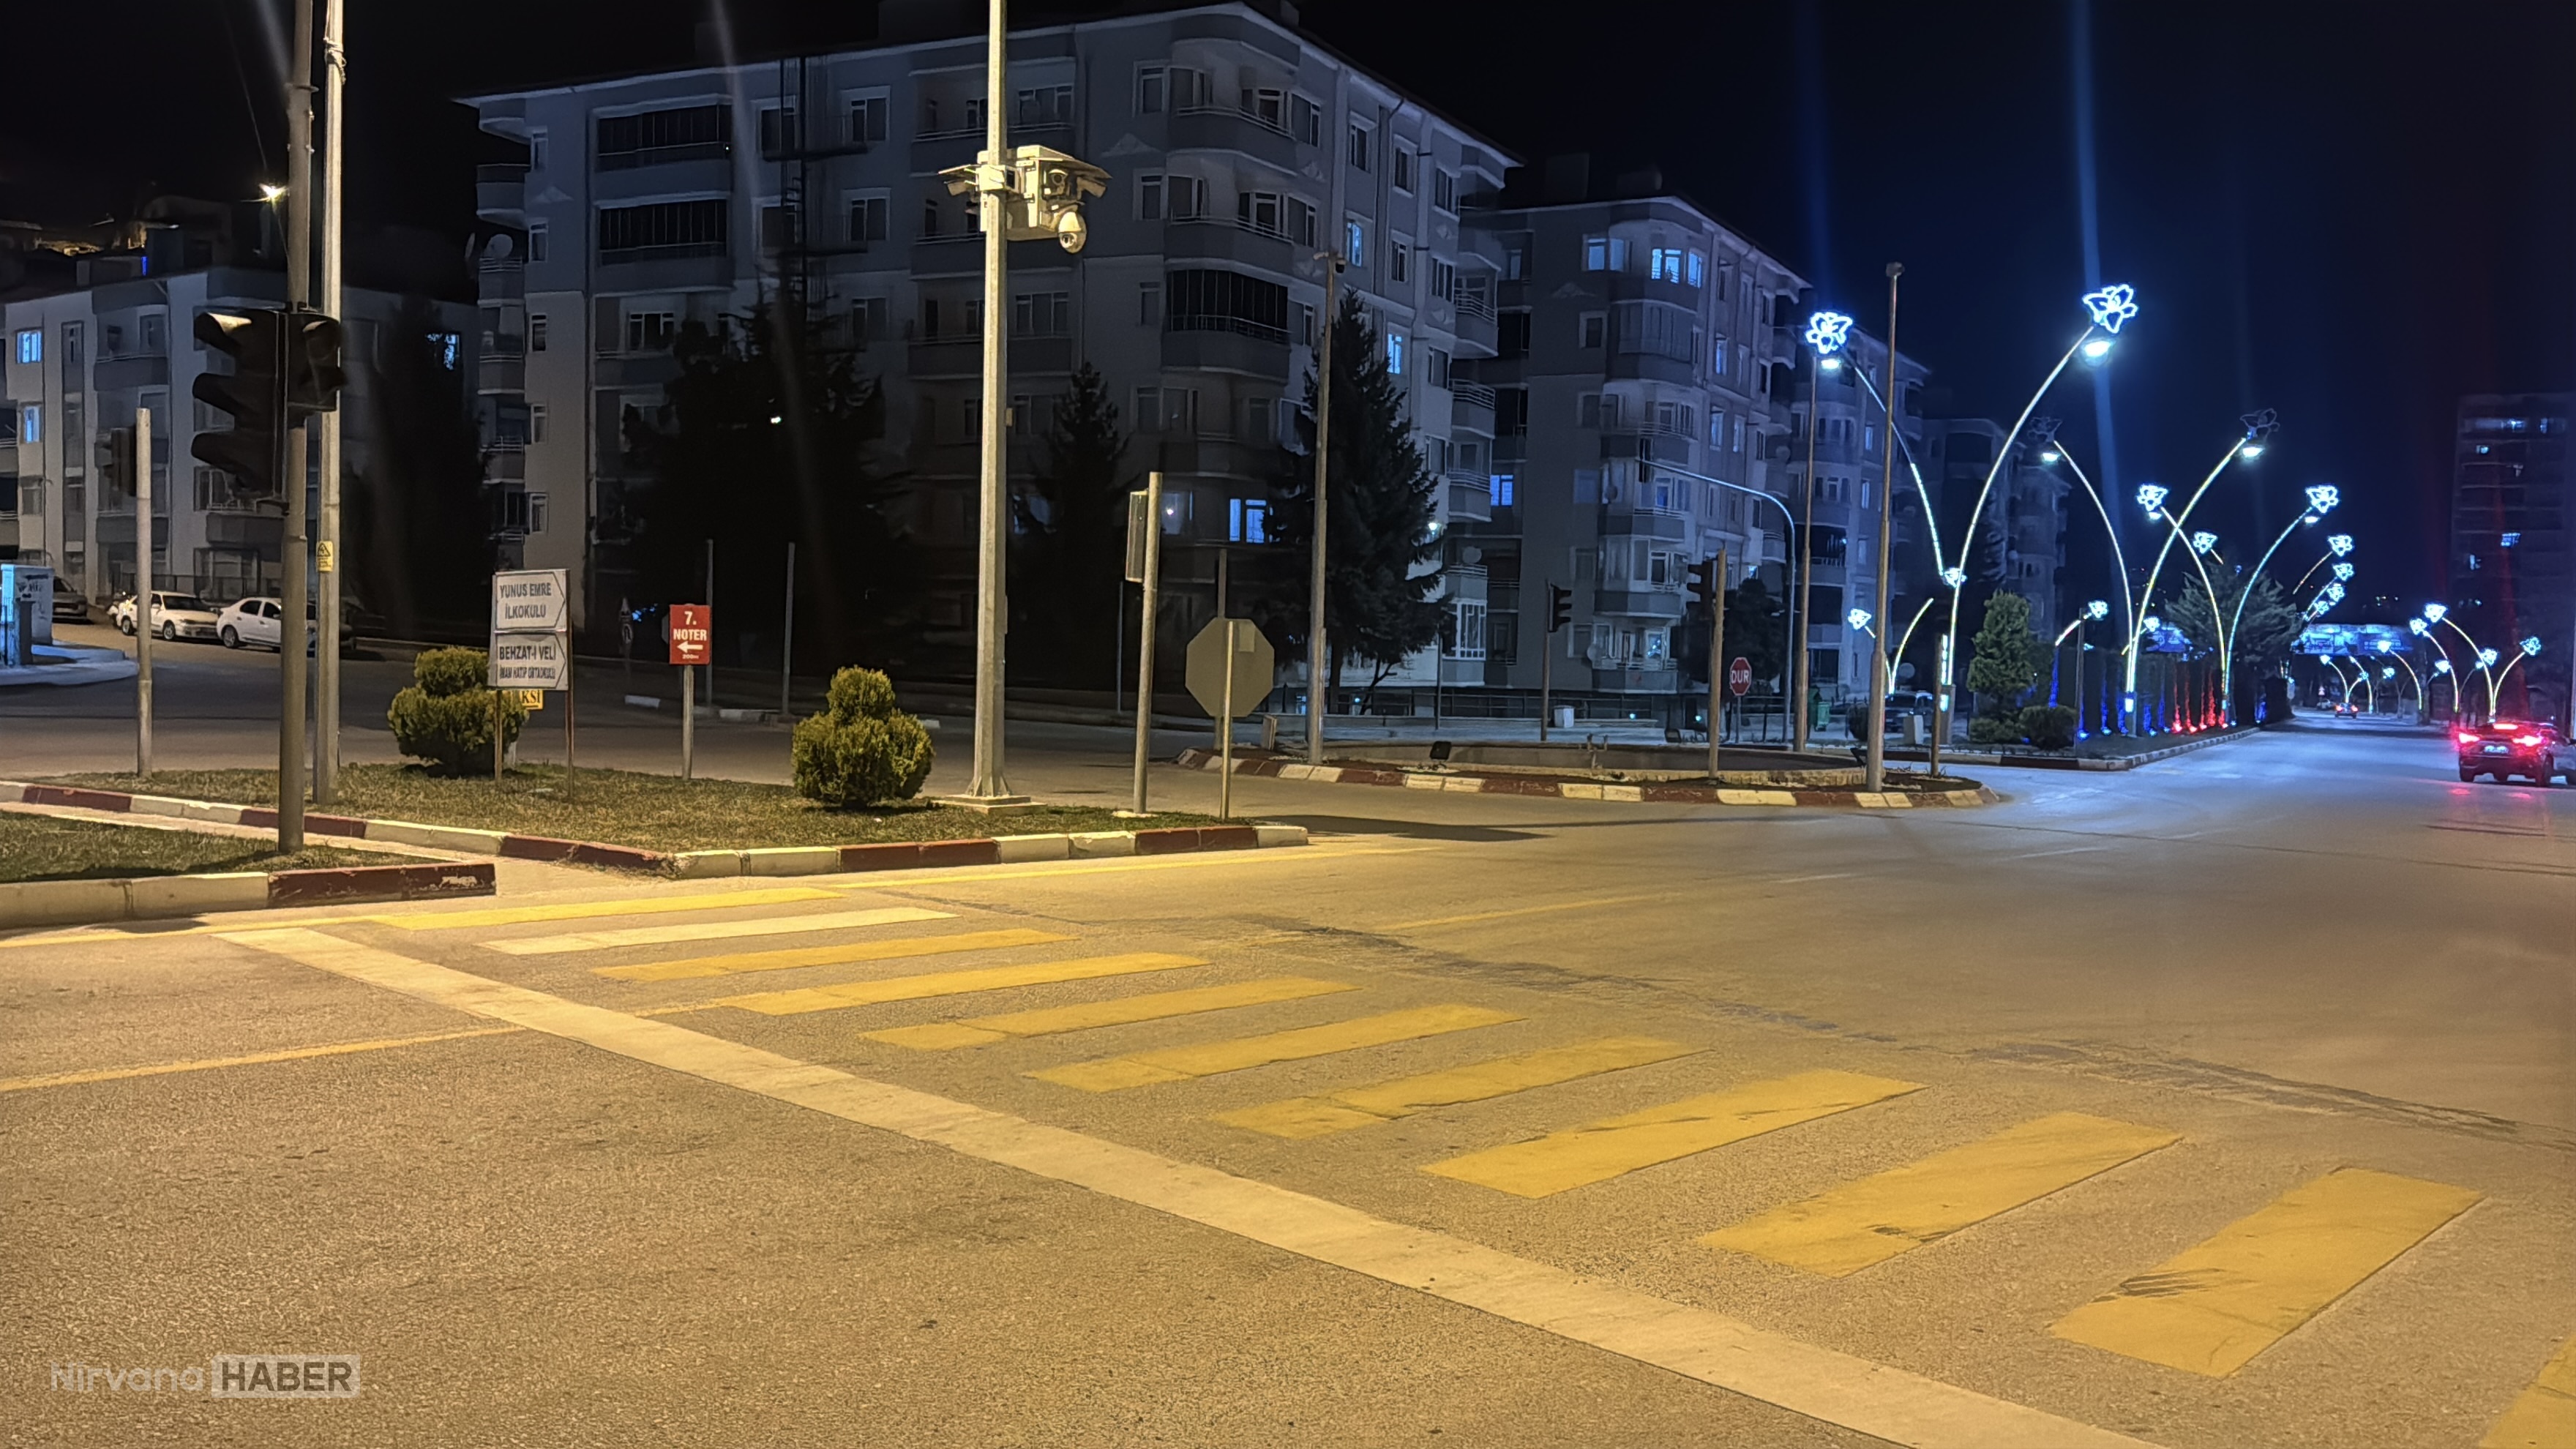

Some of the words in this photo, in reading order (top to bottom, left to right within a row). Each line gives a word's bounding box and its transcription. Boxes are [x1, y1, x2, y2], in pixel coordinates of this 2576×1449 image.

[500, 583, 528, 599] YUNUS
[529, 583, 552, 596] EMRE
[505, 603, 546, 619] İLKOKULU
[684, 611, 697, 625] 7.
[673, 629, 708, 641] NOTER
[1731, 670, 1749, 684] DUR
[522, 689, 540, 703] KSİ
